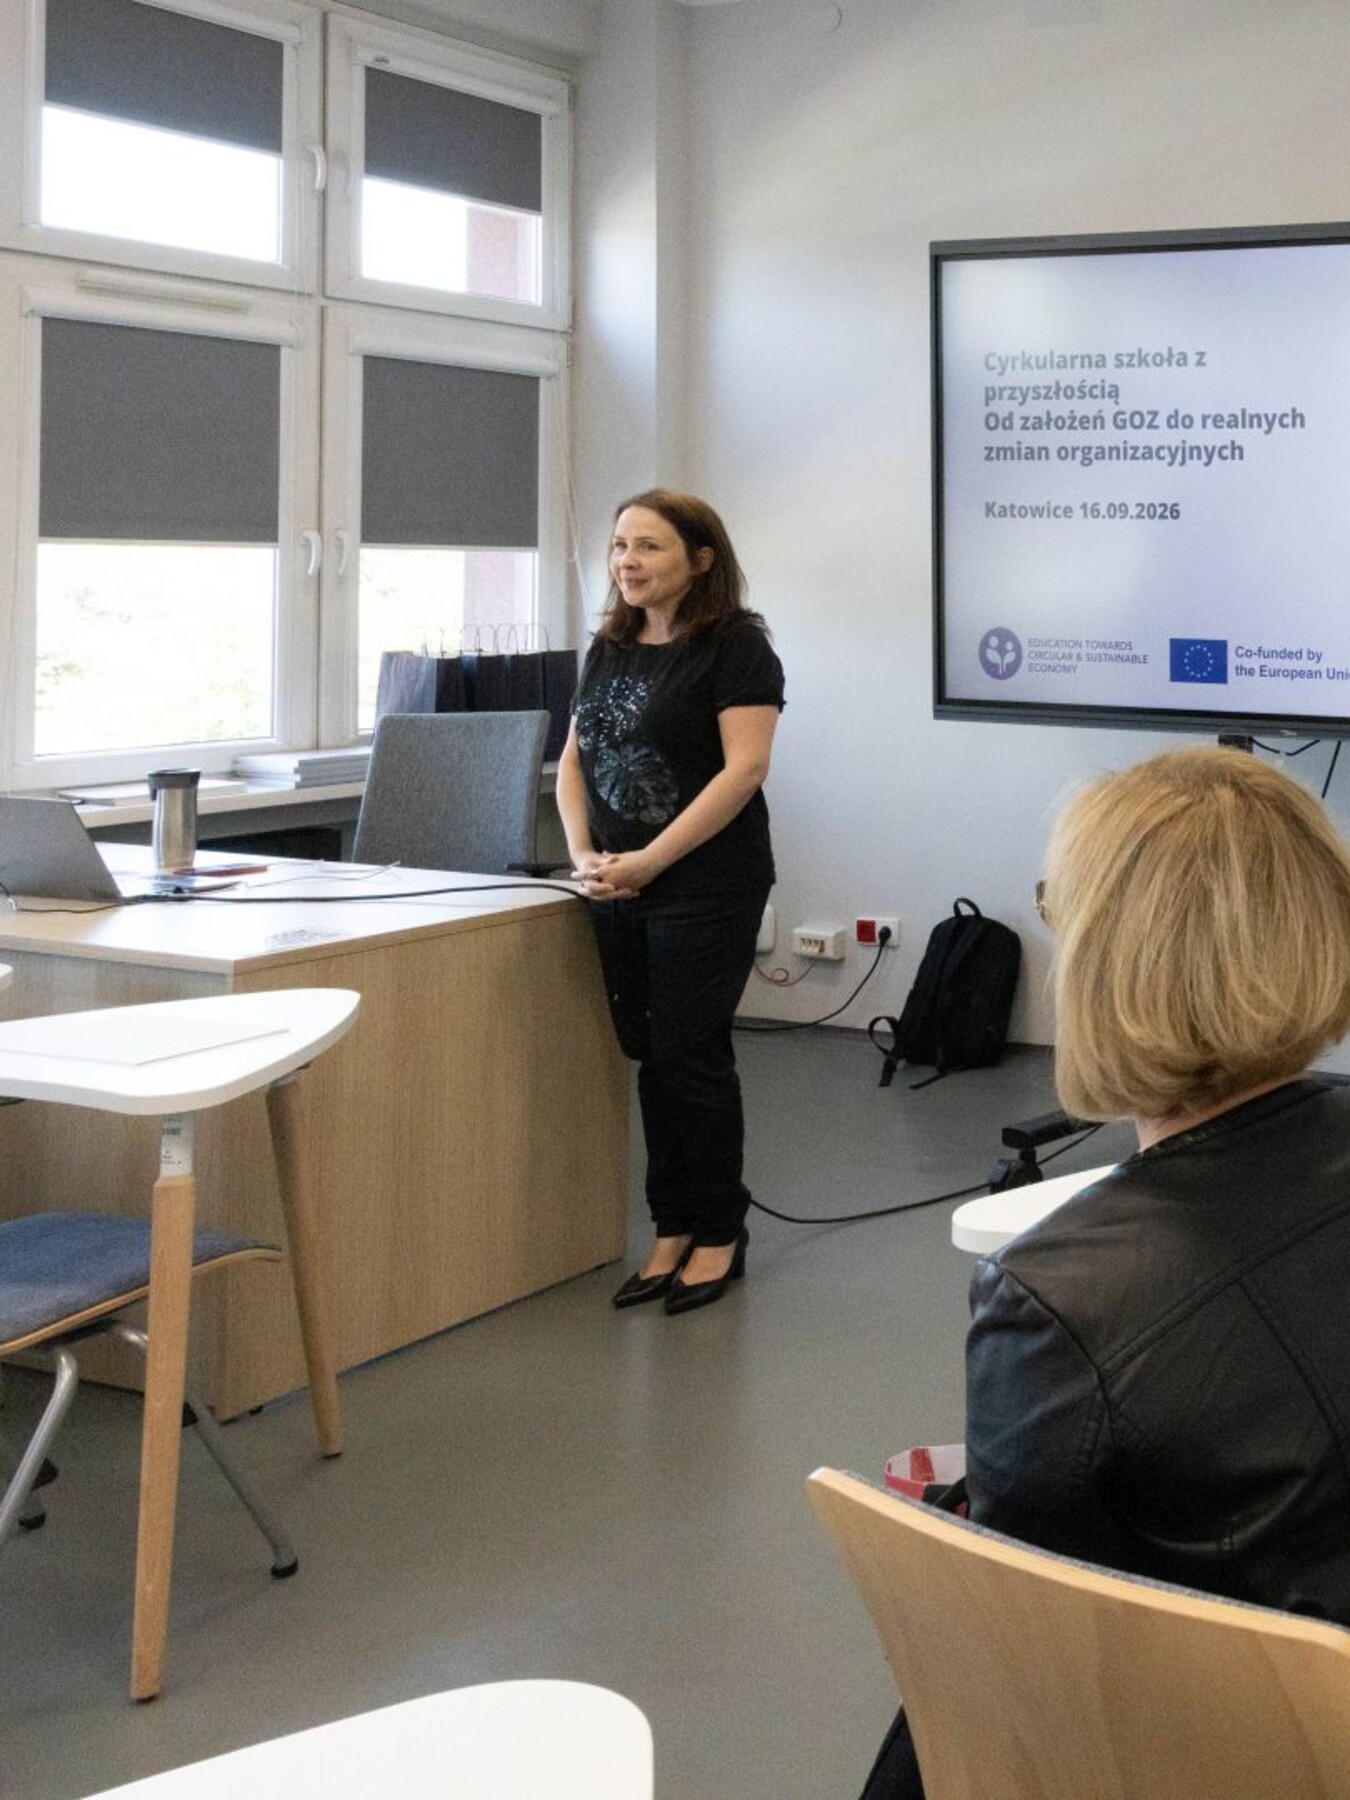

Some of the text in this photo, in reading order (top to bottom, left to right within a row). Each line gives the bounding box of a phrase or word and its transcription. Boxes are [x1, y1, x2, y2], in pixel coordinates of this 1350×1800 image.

[984, 347, 1207, 376] Cyrkularna szkoła z
[984, 379, 1120, 406] przyszłością
[984, 407, 1306, 435] Od założeń GOZ do realnych
[984, 440, 1245, 467] zmian organizacyjnych
[985, 501, 1181, 520] Katowice 16.09.2026
[1028, 638, 1133, 651] EDUCATION TOWARDS
[1028, 650, 1149, 664] CIRCULAR & SUSTAINABLE
[1235, 646, 1323, 664] Co-funded by
[1028, 663, 1078, 674] ECONOMY
[1235, 665, 1256, 677] the
[1259, 665, 1323, 681] European
